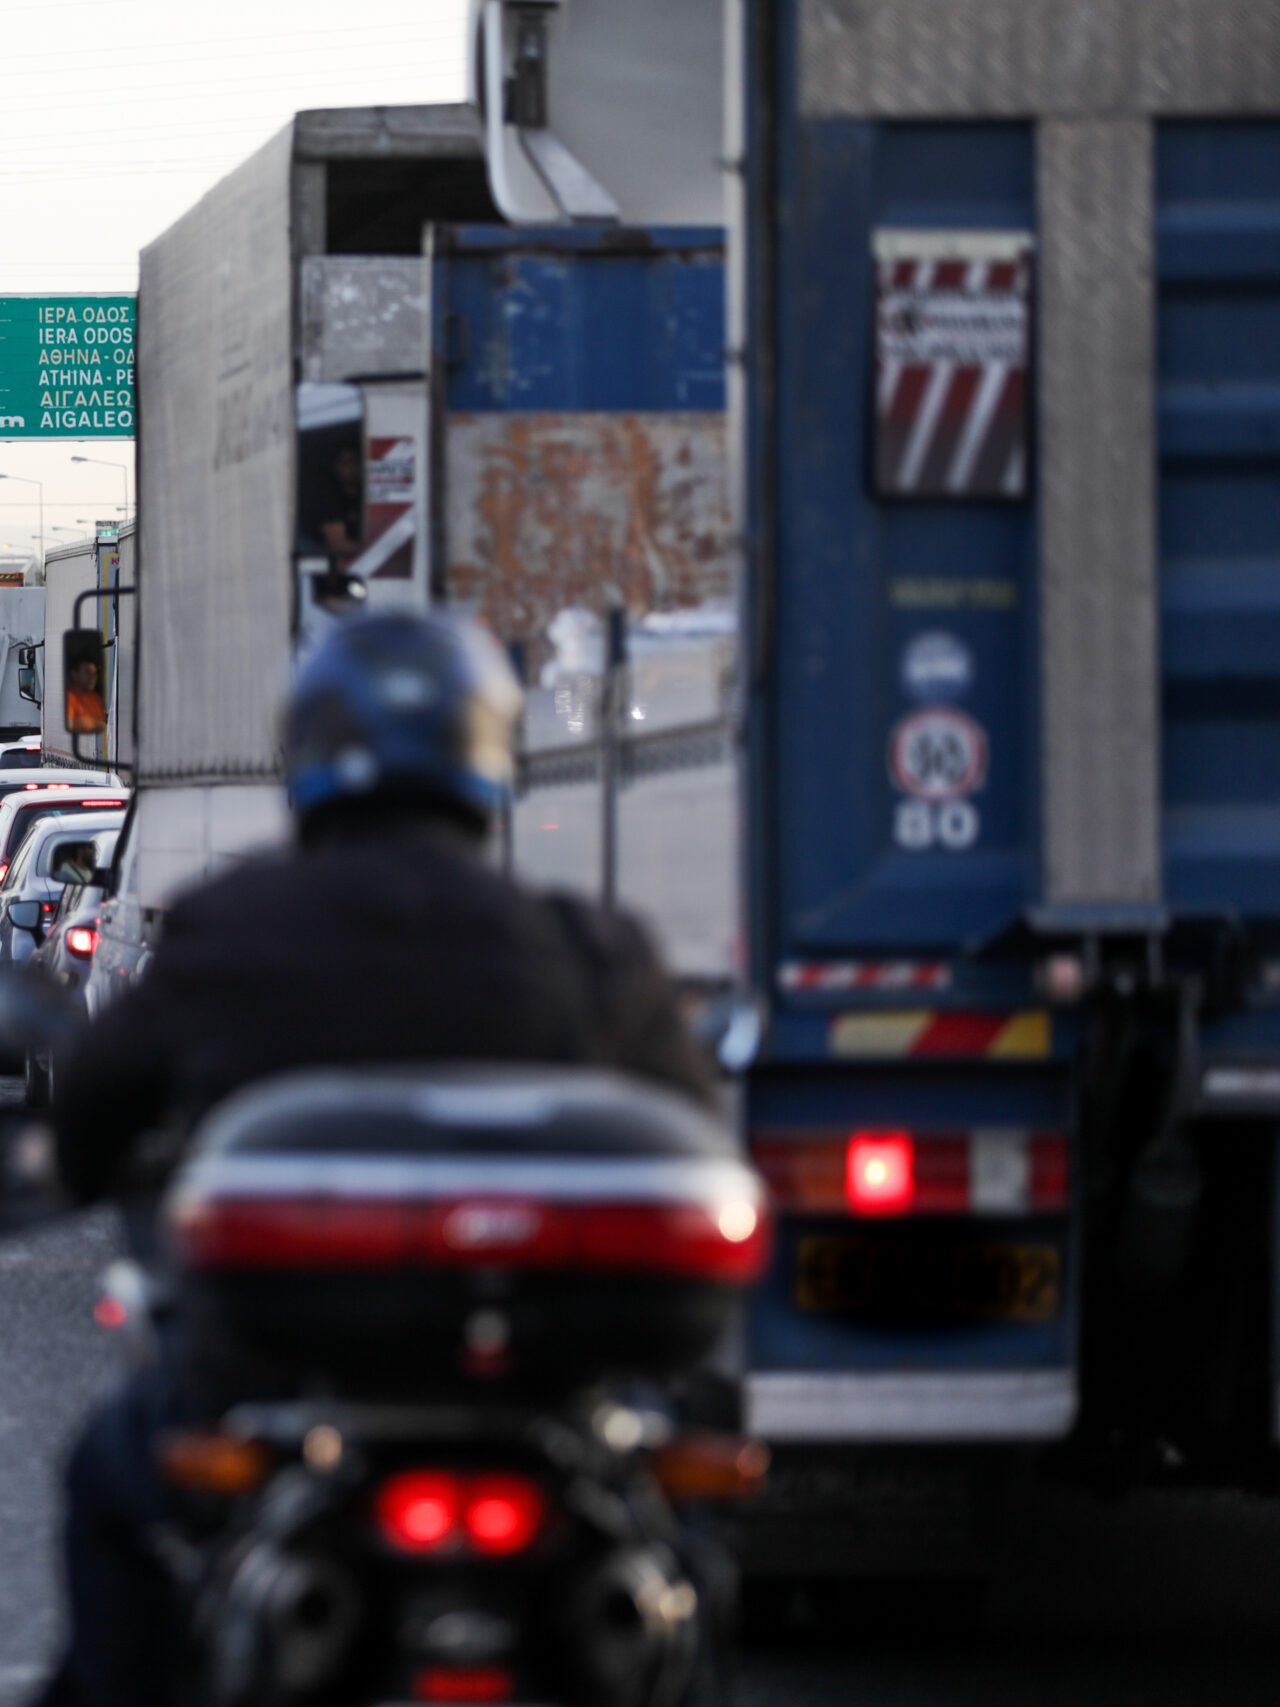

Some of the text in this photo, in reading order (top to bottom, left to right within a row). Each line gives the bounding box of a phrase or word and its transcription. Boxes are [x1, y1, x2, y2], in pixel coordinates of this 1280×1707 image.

[39, 306, 129, 324] ΙΕΡΑ ΟΔΟΣ
[39, 327, 132, 345] IERA ODOS
[38, 348, 101, 366] ΑΘΗΝΑ
[38, 369, 103, 386] ATHINA
[40, 390, 131, 407] ΑΙΓΑΛΕΩ
[40, 411, 132, 428] AIGALEO
